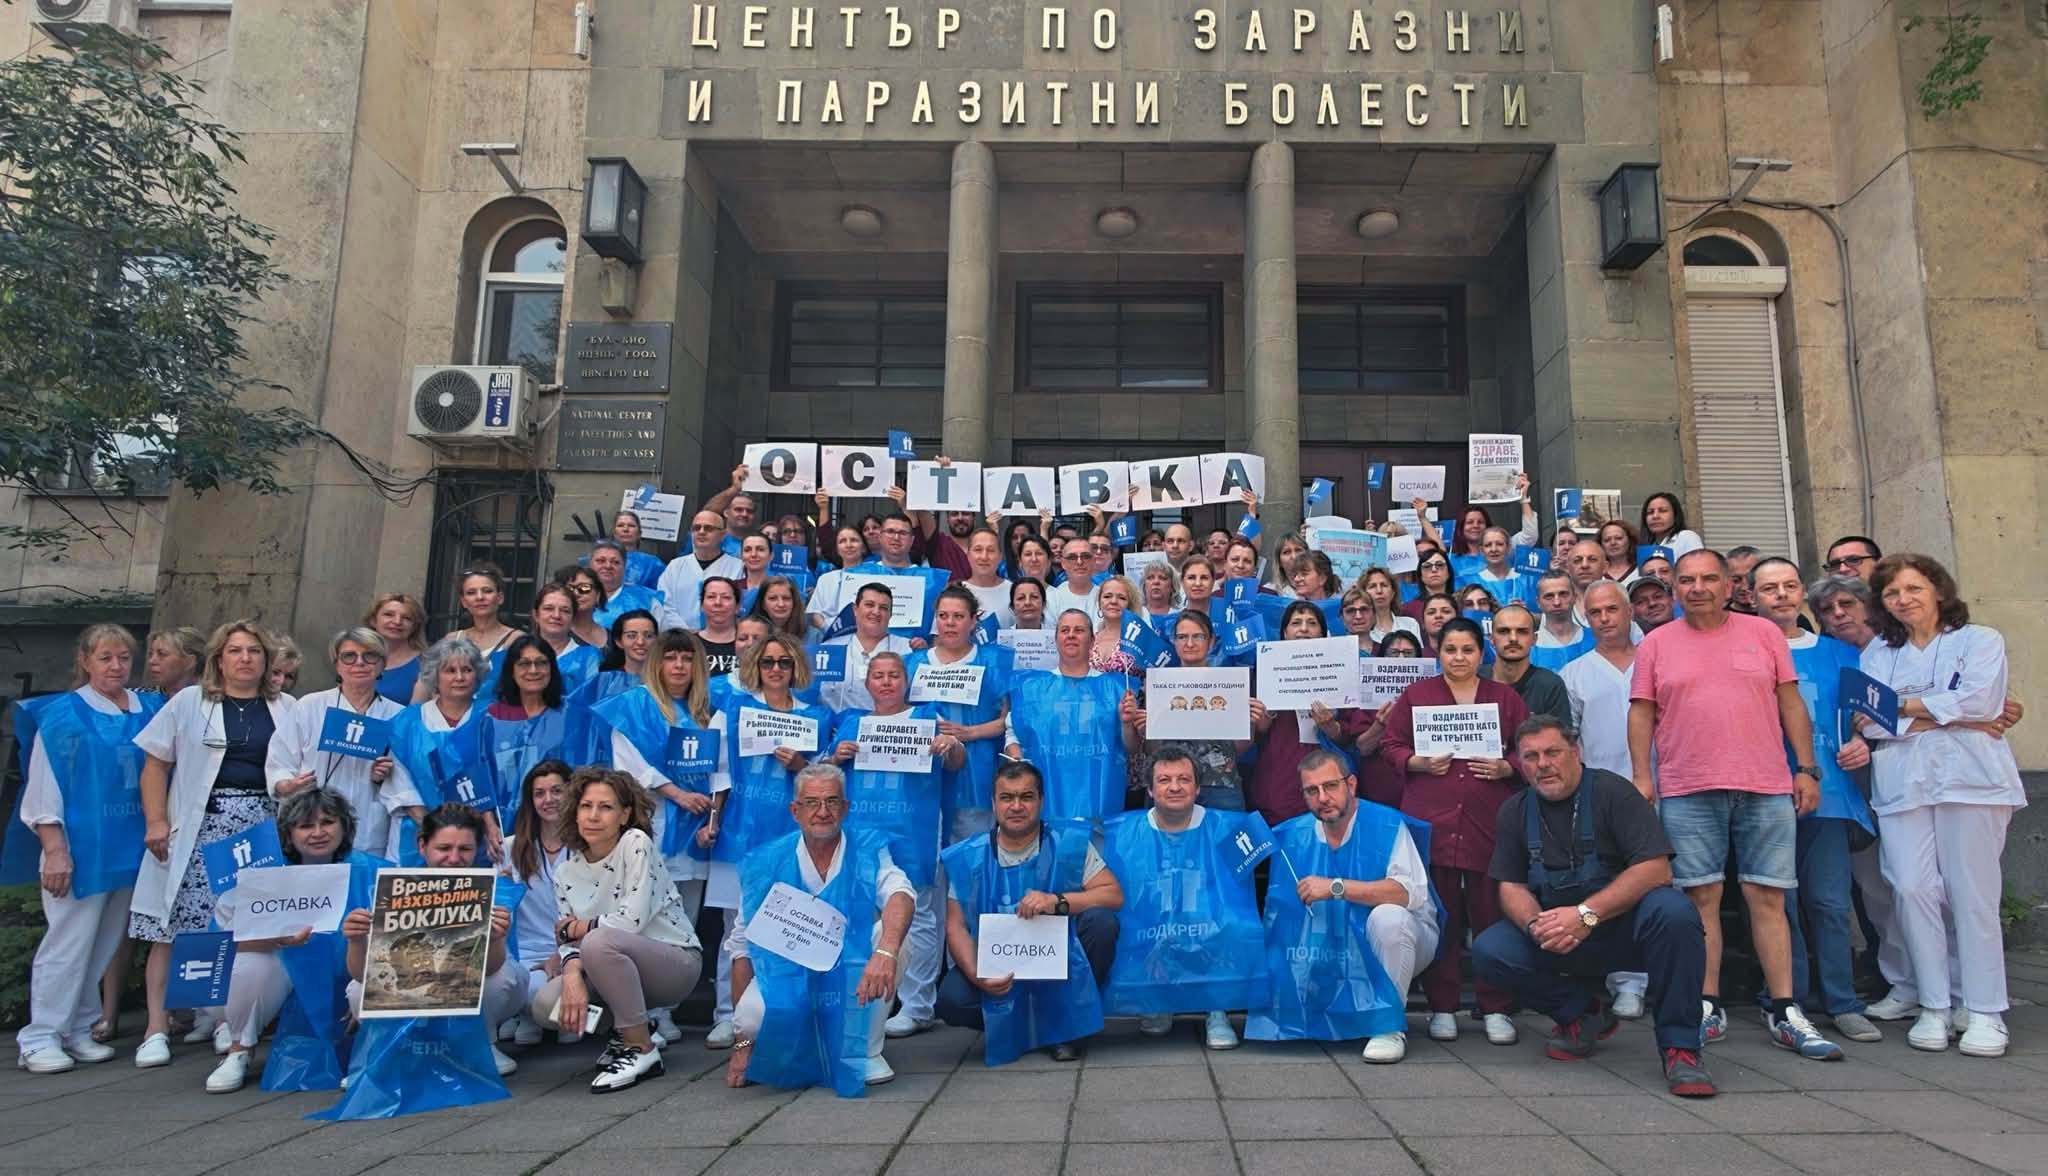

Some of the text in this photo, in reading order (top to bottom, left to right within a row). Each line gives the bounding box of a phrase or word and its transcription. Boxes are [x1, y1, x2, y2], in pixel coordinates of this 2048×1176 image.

[690, 4, 1526, 52] ЦЕНТЪР ПО ЗАРАЗНИ
[687, 79, 1529, 127] И ПАРАЗИТНИ БОЛЕСТИ
[571, 409, 653, 420] NATIONAL CENTER
[637, 430, 656, 440] AND
[1399, 480, 1438, 490] ОСТАВКА
[1377, 665, 1419, 673] ОЗДРАВЕТЕ
[1362, 675, 1415, 684] ДРУЖЕСТВОТО
[1375, 686, 1385, 694] СИ
[757, 713, 791, 724] ОСТАВКА
[1432, 712, 1479, 722] ОЗДРАВЕТЕ
[746, 720, 812, 734] РЪКОВОДСТВОТО
[876, 724, 918, 735] ОЗДРАВЕТЕ
[1416, 722, 1498, 733] ДРУЖЕСТВОТО КАТО
[757, 729, 767, 737] НА
[768, 730, 783, 738] БУЛ
[1431, 733, 1484, 742] СИ ТРЪГНЕТЕ
[859, 734, 932, 746] ДРУЖЕСТВОТО КАТО
[871, 745, 918, 756] СИ ТРЪГНЕТЕ
[391, 877, 473, 896] Време да
[250, 896, 332, 914] ОСТАВКА
[384, 903, 483, 932] БОКЛУКА
[789, 909, 824, 929] ОСТАВКА
[763, 910, 839, 947] на ръководството на
[782, 927, 811, 946] Бул Био
[991, 943, 1057, 957] ОСТАВКА
